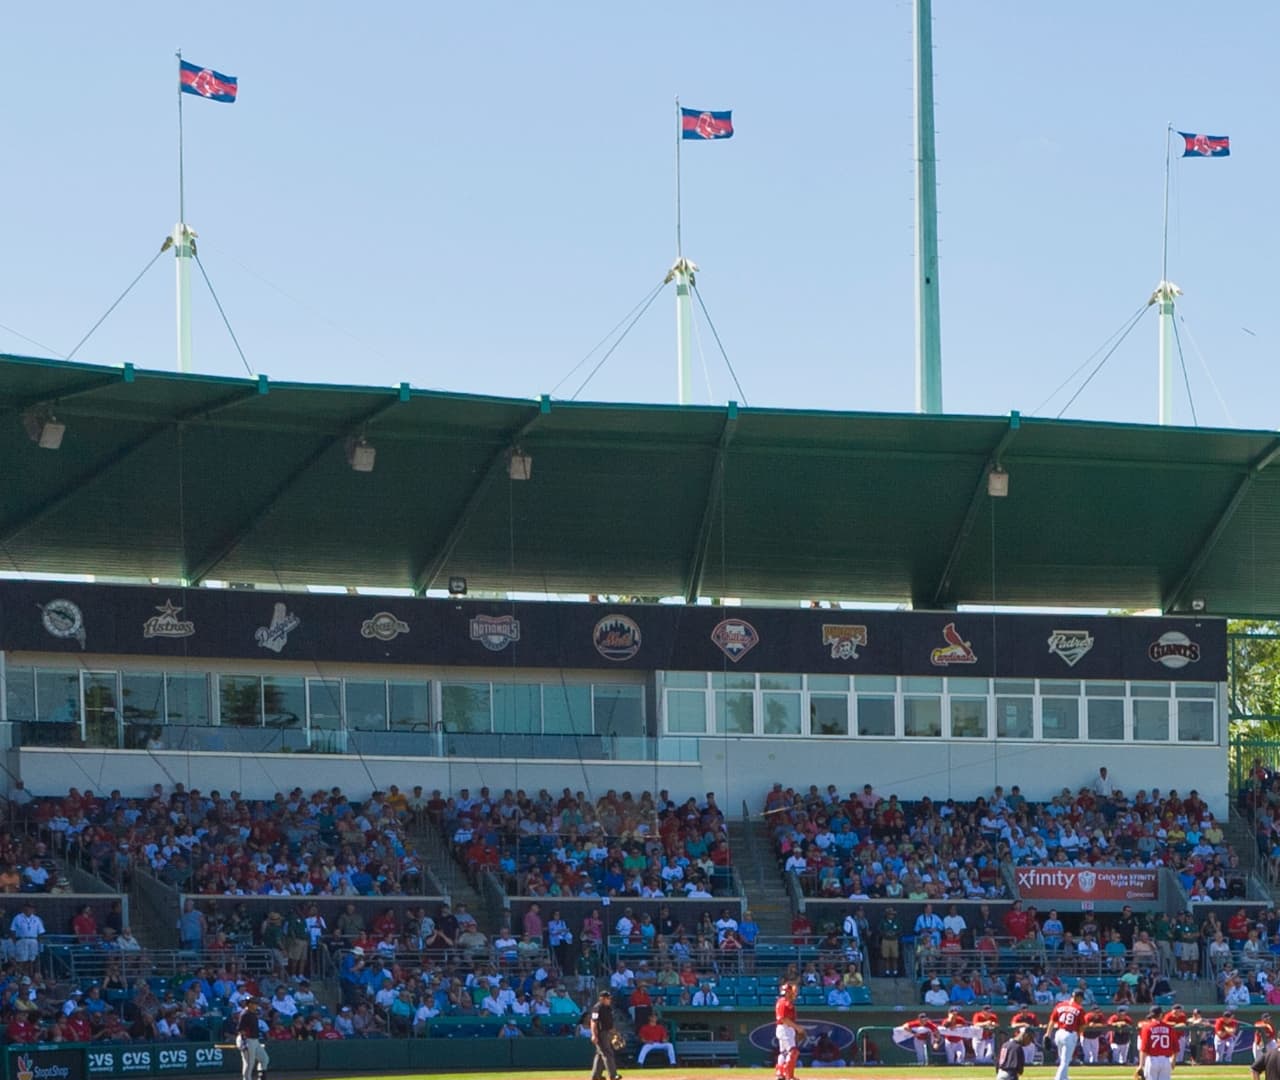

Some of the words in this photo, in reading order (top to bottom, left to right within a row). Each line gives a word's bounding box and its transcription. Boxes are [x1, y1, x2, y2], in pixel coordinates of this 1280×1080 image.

[145, 617, 194, 636] Astros
[1048, 634, 1094, 653] Padres
[1018, 869, 1075, 889] xfinity
[1150, 1034, 1170, 1049] 70
[122, 1051, 151, 1065] CVS
[159, 1049, 188, 1063] CVS
[195, 1048, 223, 1061] CVS
